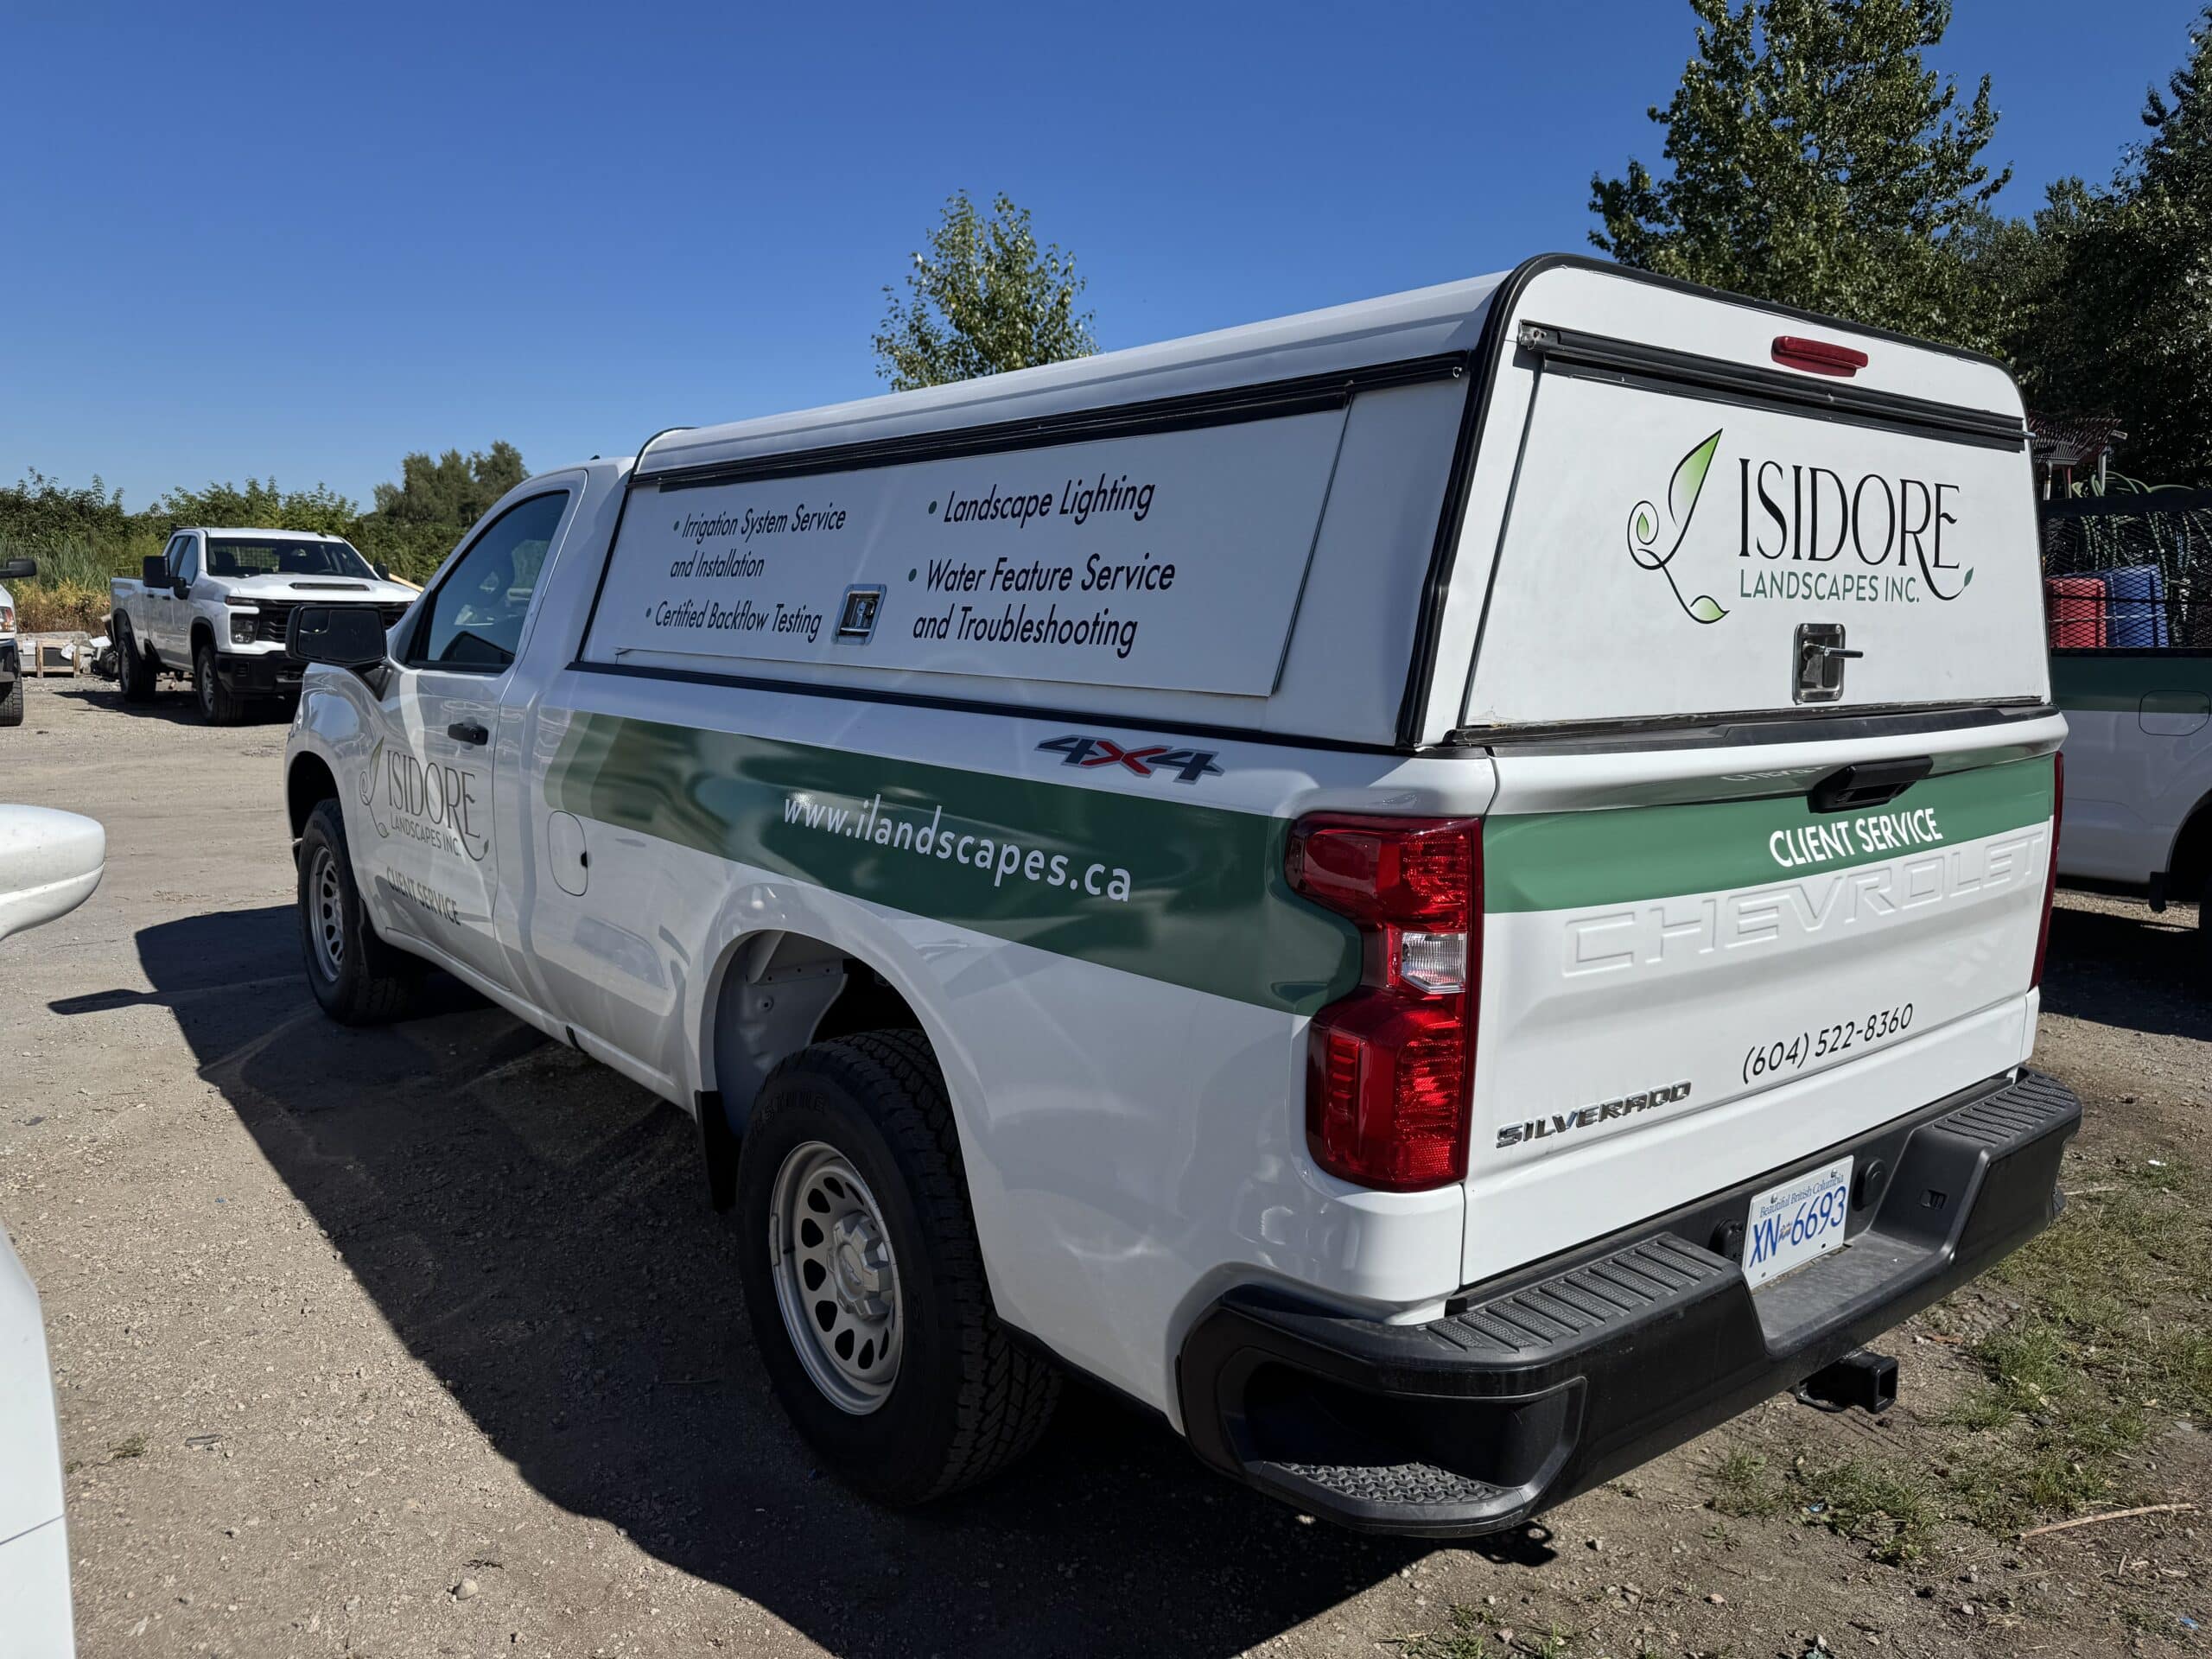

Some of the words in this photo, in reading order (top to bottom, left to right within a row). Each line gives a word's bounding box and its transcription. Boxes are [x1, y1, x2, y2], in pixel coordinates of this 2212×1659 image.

[682, 511, 738, 544] Irrigation
[741, 508, 788, 543] System
[791, 502, 846, 532] Service
[944, 483, 1053, 529] Landscape
[1058, 473, 1156, 525] Lighting
[1738, 458, 1966, 601] ISIDORE
[670, 550, 698, 577] and
[695, 548, 766, 578] Installation
[926, 558, 987, 593] Water
[989, 556, 1073, 592] Feature
[1081, 552, 1176, 591] Service
[1740, 569, 1879, 602] LANDSCAPES
[1885, 575, 1920, 603] INC.
[655, 598, 710, 628] Certified
[707, 600, 770, 632] Backflow
[771, 603, 823, 644] Testing
[912, 602, 955, 640] and
[957, 603, 1138, 659] Troubleshooting
[387, 749, 484, 861] ISIDORE
[390, 812, 442, 849] LANDSCAPES
[442, 834, 462, 857] INC.
[784, 793, 1133, 903] www.ilandscapes.ca
[1769, 821, 1855, 868] CLIENT
[1855, 808, 1944, 853] SERVICE
[386, 866, 417, 903] CLIENT
[417, 881, 461, 927] SERVICE
[1561, 830, 2044, 978] CHEVROLET
[1743, 1032, 1809, 1085] (604)
[1815, 1002, 1914, 1058] 522-8360
[1496, 1078, 1692, 1149] SILVERADO
[1759, 1192, 1790, 1218] Beautiful
[1790, 1185, 1812, 1205] British
[1812, 1173, 1844, 1195] Columbia
